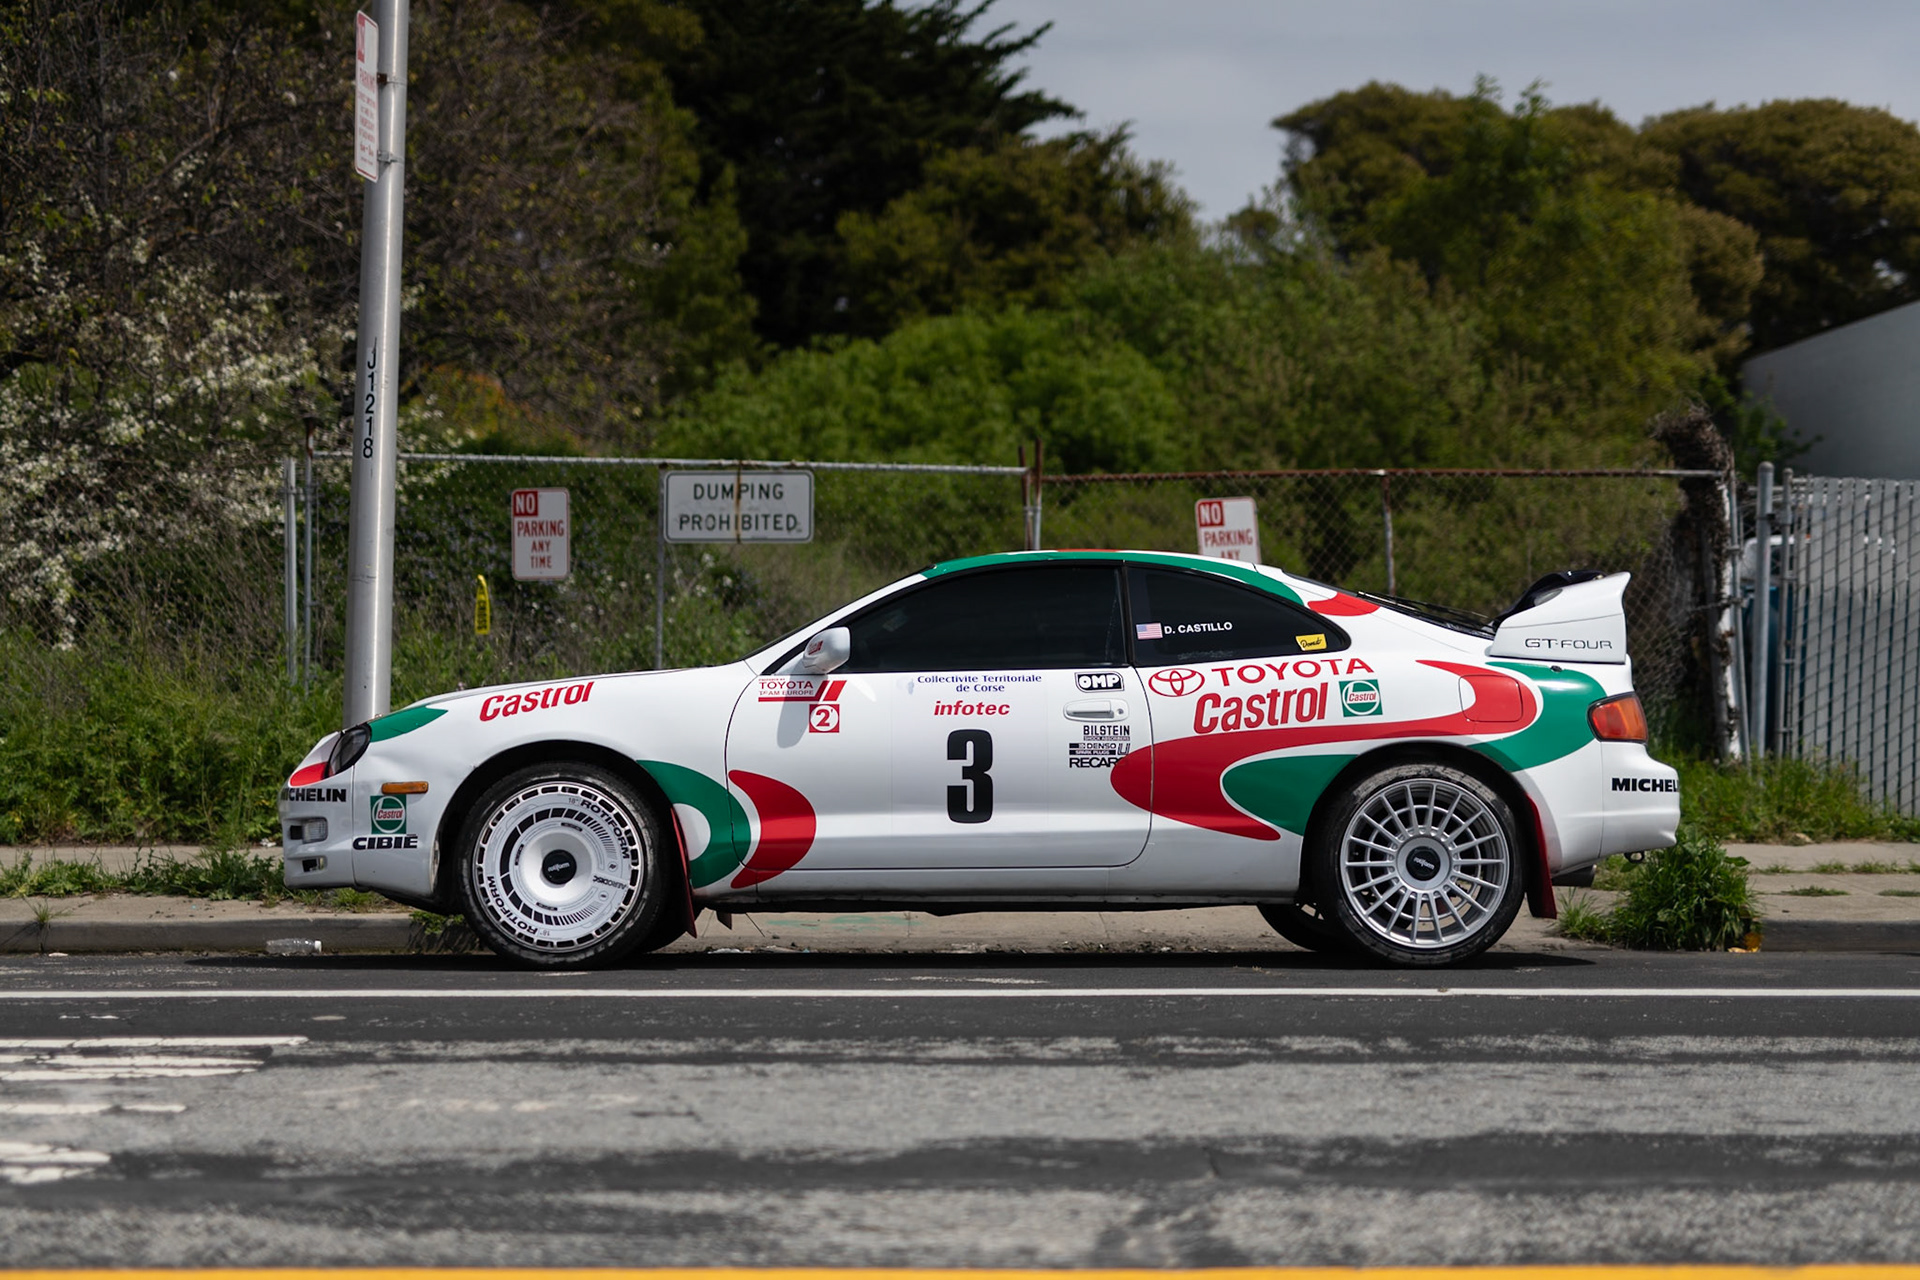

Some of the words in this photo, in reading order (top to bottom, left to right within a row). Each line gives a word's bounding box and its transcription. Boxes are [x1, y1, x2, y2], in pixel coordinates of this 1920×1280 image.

[363, 345, 377, 459] J1218
[693, 483, 784, 500] DUMPING
[515, 493, 536, 514] NO
[1199, 503, 1222, 525] NO
[517, 520, 565, 537] PARKING
[679, 514, 799, 531] PROHIBITED
[1204, 528, 1253, 547] PARKING
[531, 540, 551, 553] ANY
[530, 555, 552, 569] TIME
[1164, 625, 1176, 635] D.
[1177, 621, 1233, 634] CASTILLO
[917, 675, 979, 683] Collectivite
[982, 674, 1042, 683] Territoriale
[1211, 658, 1374, 687] TOYOTA
[759, 680, 814, 690] TOYOTA
[955, 684, 970, 693] de
[973, 684, 1005, 693] Corse
[1078, 674, 1120, 689] OMP
[479, 681, 594, 722] Castrol
[1348, 691, 1377, 703] Castrol
[933, 700, 1011, 716] infotec
[1193, 682, 1328, 734] Castrol
[1083, 725, 1130, 736] BILSTEIN
[1069, 757, 1124, 768] RECAR
[947, 729, 993, 824] 3
[1611, 777, 1680, 792] MICHEL
[377, 809, 404, 819] Castrol
[580, 799, 630, 859] ROTIFORM
[486, 876, 538, 934] ROTIFORM
